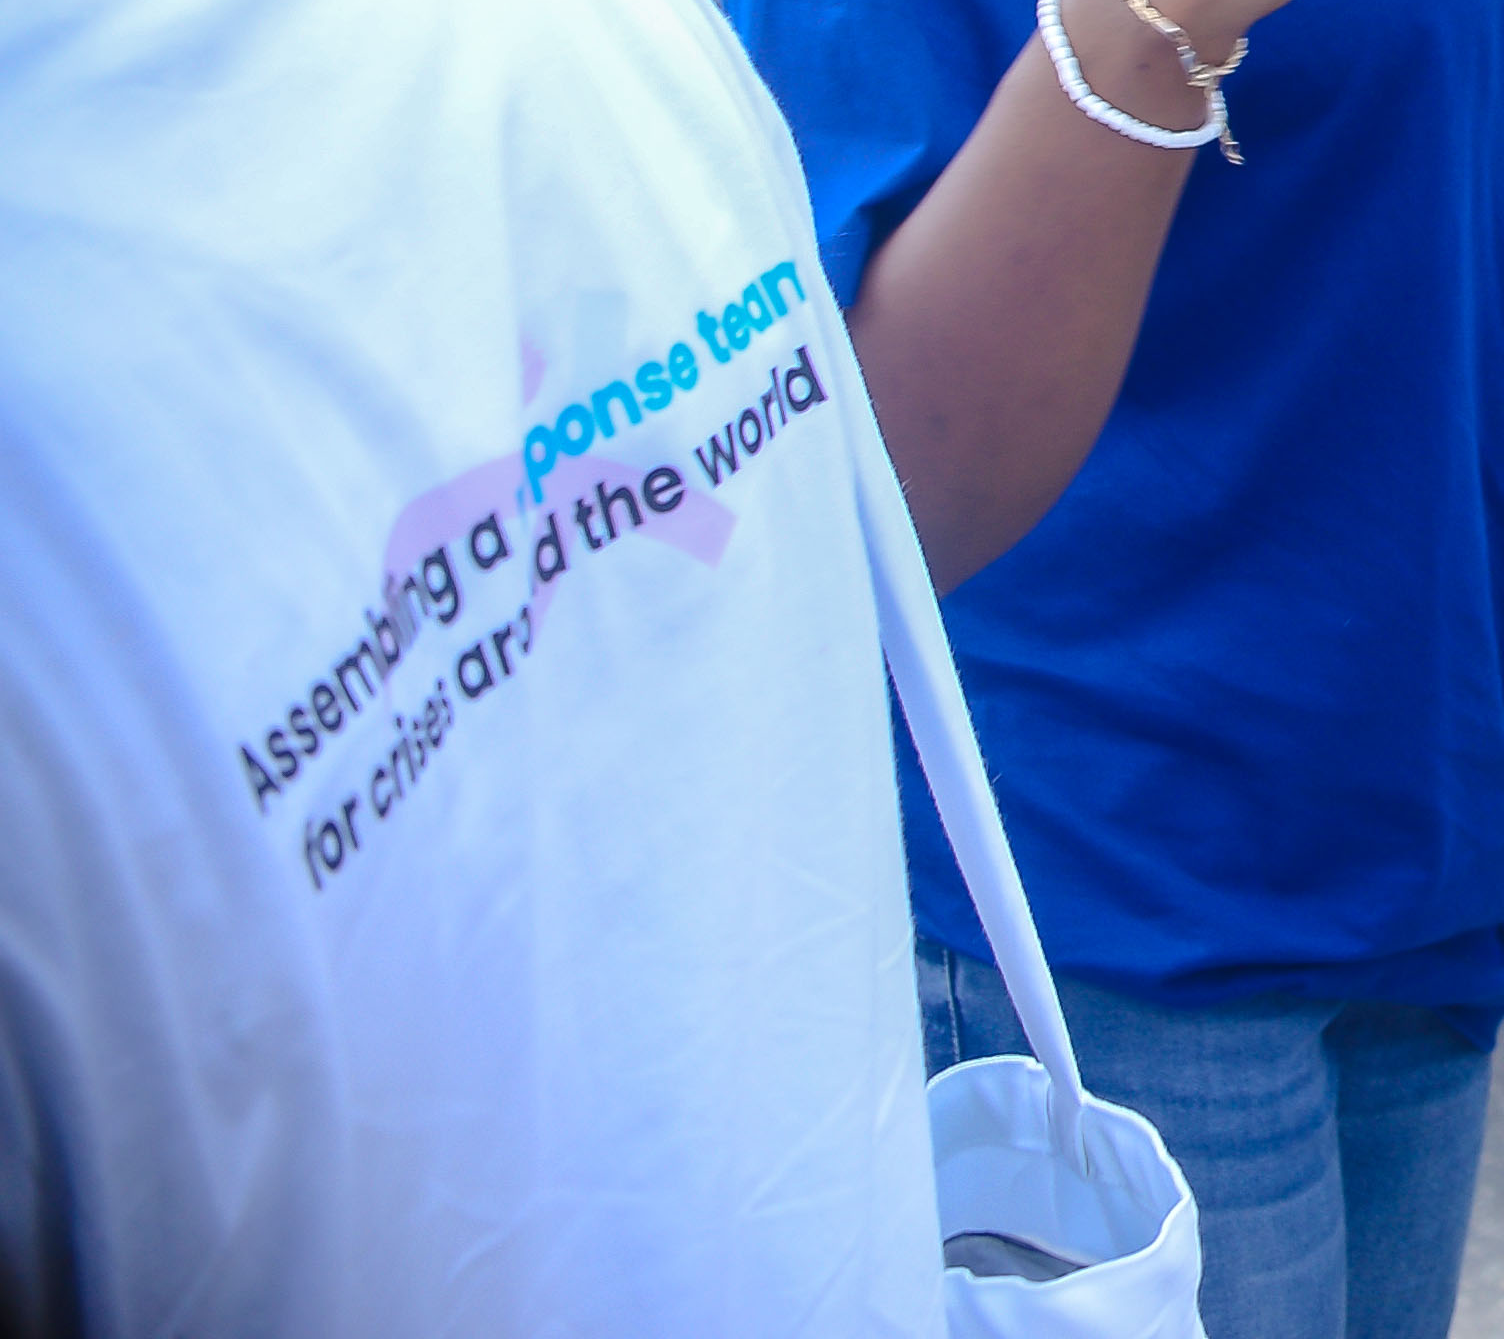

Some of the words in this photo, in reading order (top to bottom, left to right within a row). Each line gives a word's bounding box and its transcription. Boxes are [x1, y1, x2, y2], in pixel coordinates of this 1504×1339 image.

[576, 467, 685, 551] the
[695, 346, 828, 487] world
[468, 513, 511, 571] a
